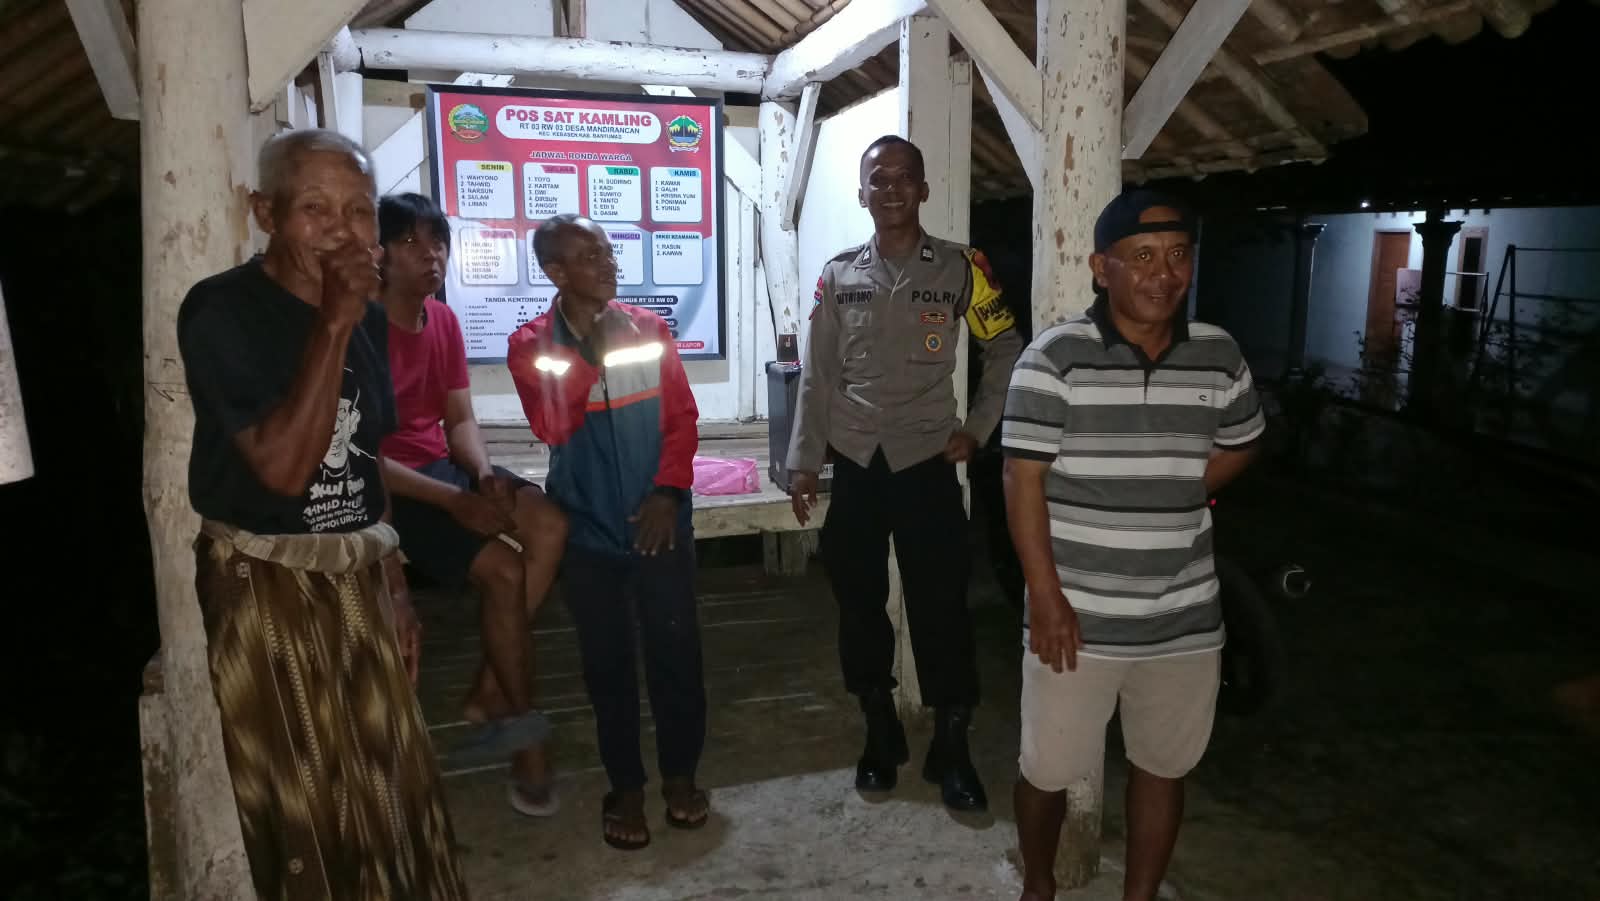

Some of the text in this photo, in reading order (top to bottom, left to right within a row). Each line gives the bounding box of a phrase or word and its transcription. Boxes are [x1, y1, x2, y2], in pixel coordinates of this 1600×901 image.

[506, 109, 652, 126] POS SAT KAMLING
[587, 126, 640, 134] MANDIRANCAN
[912, 291, 956, 304] POLRI
